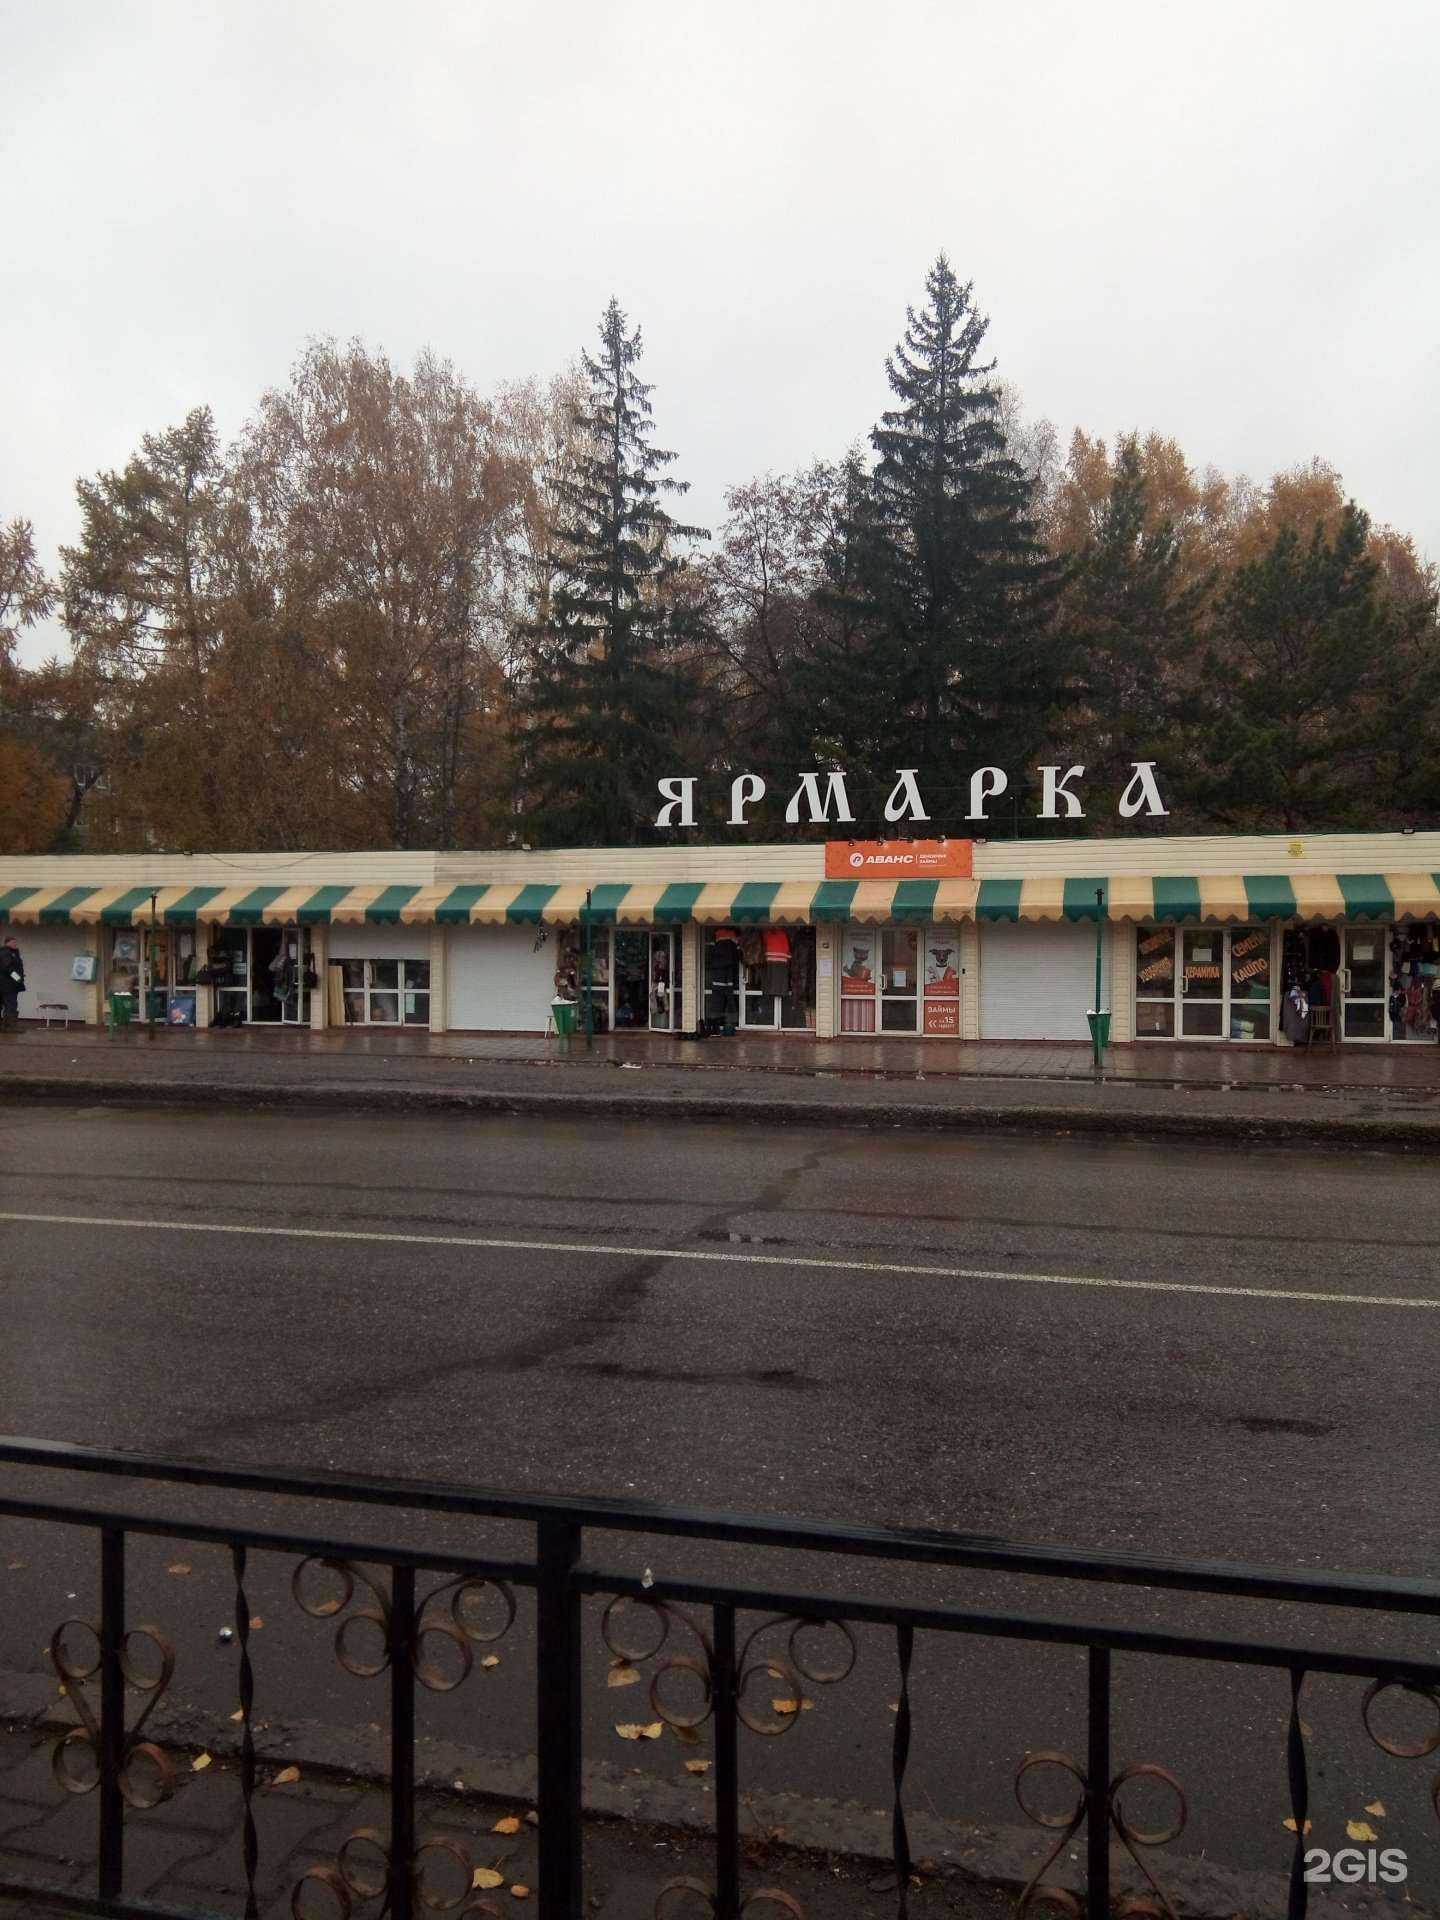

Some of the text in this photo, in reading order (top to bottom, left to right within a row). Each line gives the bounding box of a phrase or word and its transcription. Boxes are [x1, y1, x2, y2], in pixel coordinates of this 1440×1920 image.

[654, 761, 1170, 827] ЯРМАРКА
[866, 855, 914, 864] АВАНС
[1232, 957, 1268, 984] КАШПО
[928, 1005, 956, 1013] ЗАЙМЫ
[944, 1016, 954, 1024] 15
